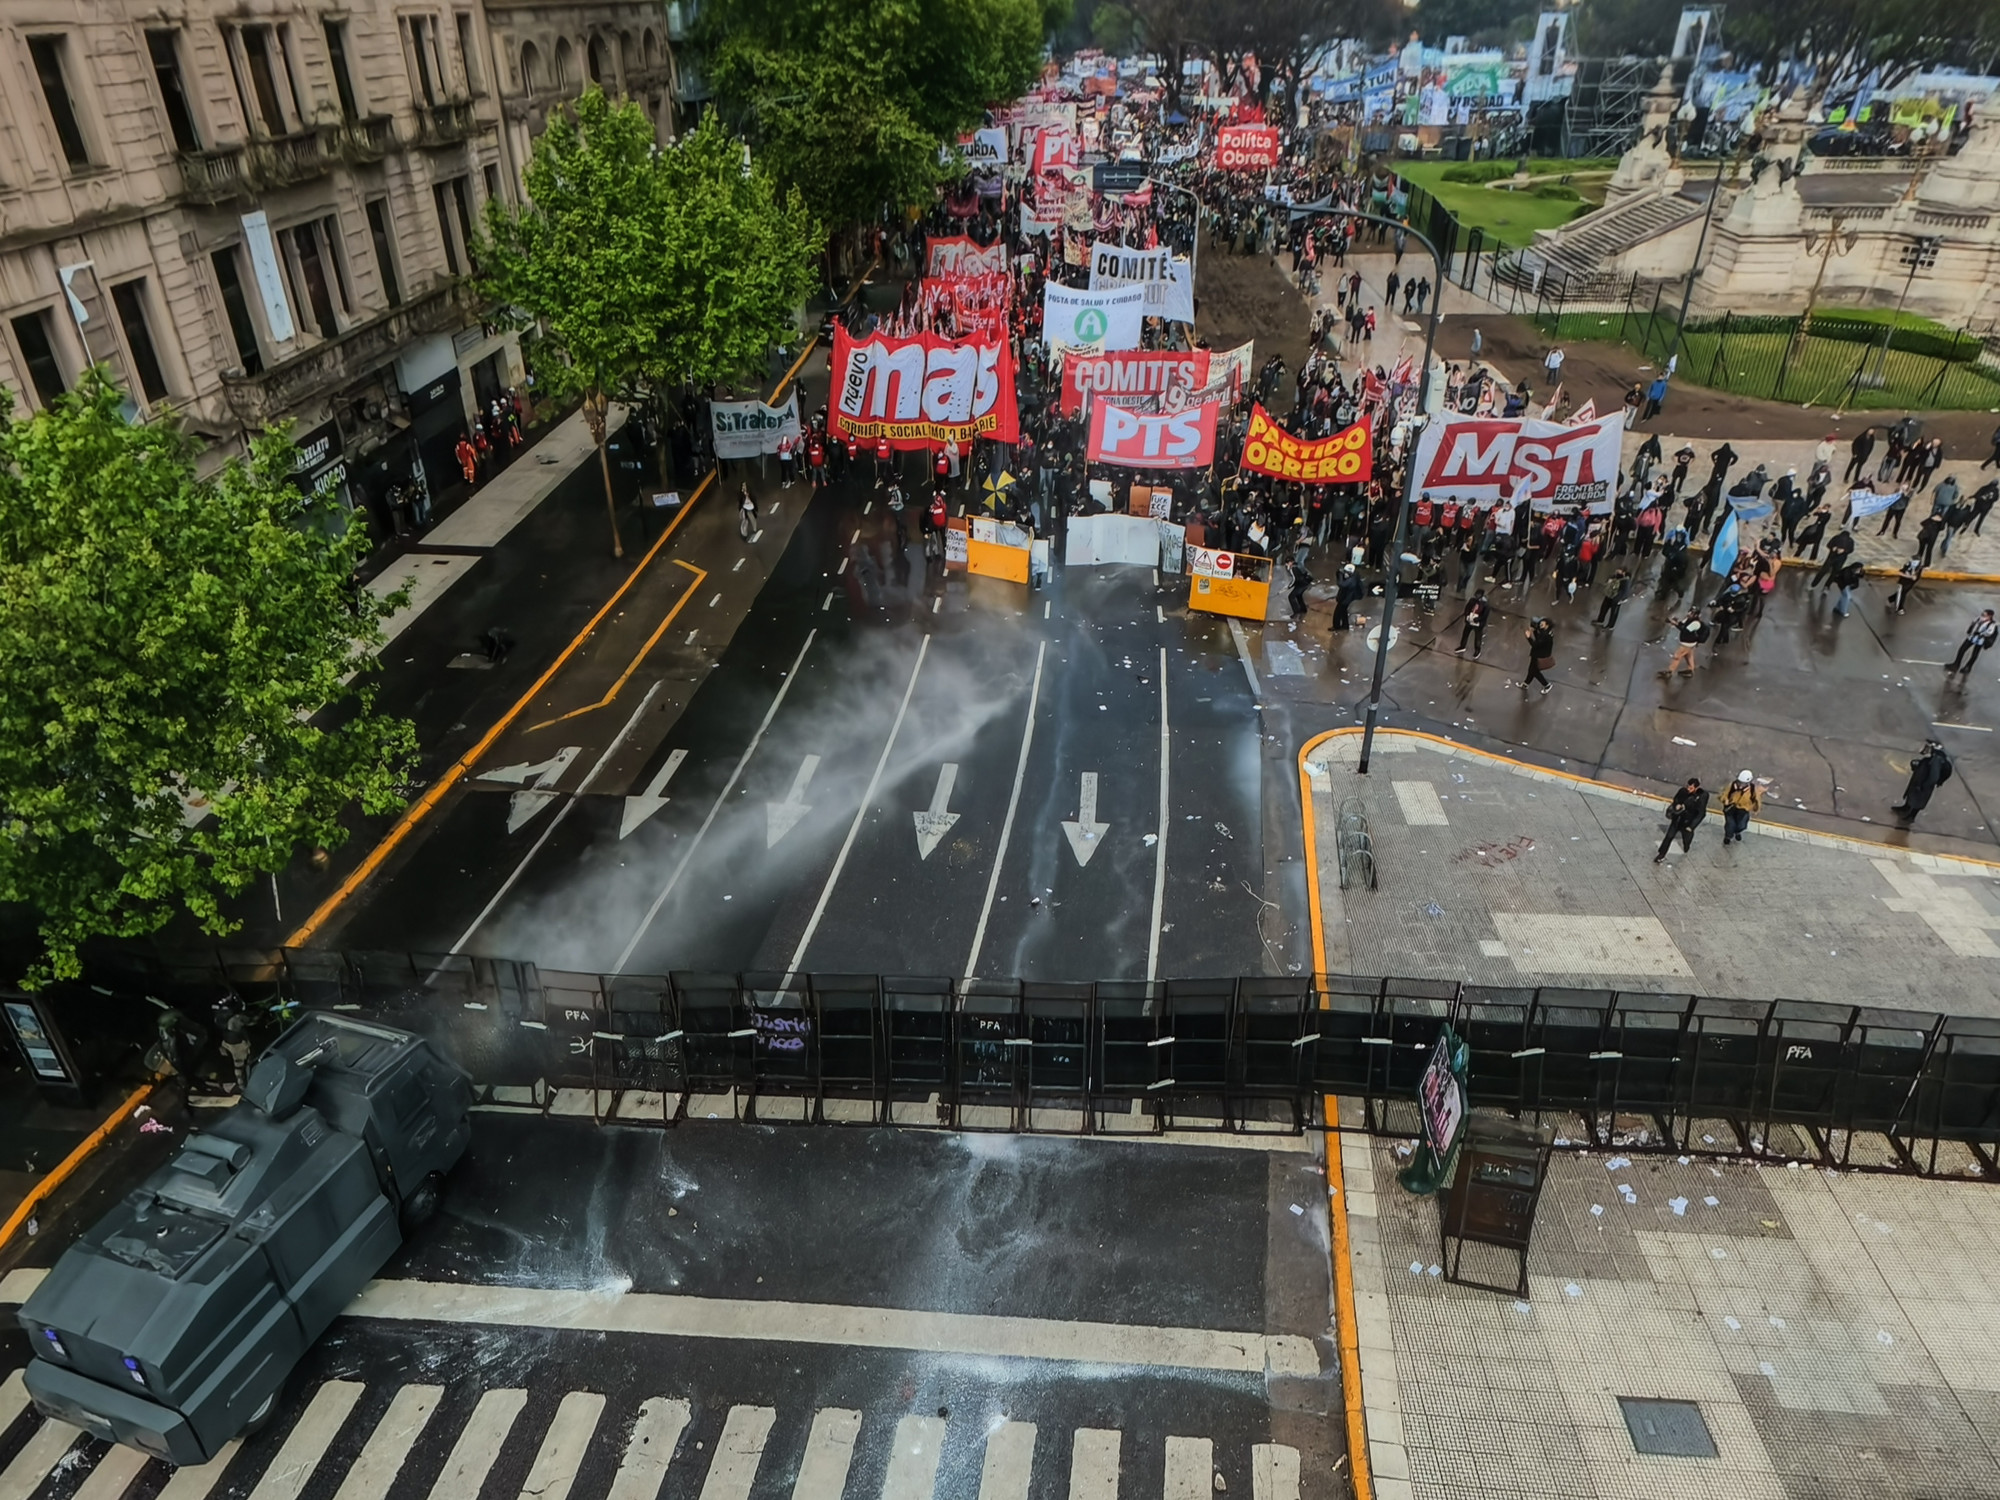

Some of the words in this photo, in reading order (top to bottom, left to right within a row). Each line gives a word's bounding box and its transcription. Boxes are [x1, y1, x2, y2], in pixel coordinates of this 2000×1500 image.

[1222, 132, 1272, 149] Polítca
[1048, 294, 1069, 305] POSTA
[1070, 297, 1079, 306] DE
[1081, 297, 1104, 306] SALUD
[844, 352, 868, 412] nuevo
[1101, 408, 1201, 457] PTS
[1249, 414, 1367, 460] PARTIDO
[1246, 442, 1361, 479] OBRERO
[1441, 432, 1601, 492] MST
[1554, 490, 1606, 500] IZQUIERDA
[1555, 483, 1593, 495] FRENTE
[565, 1010, 590, 1021] PFA
[980, 1020, 1000, 1031] PFA
[1785, 1045, 1812, 1062] PFA
